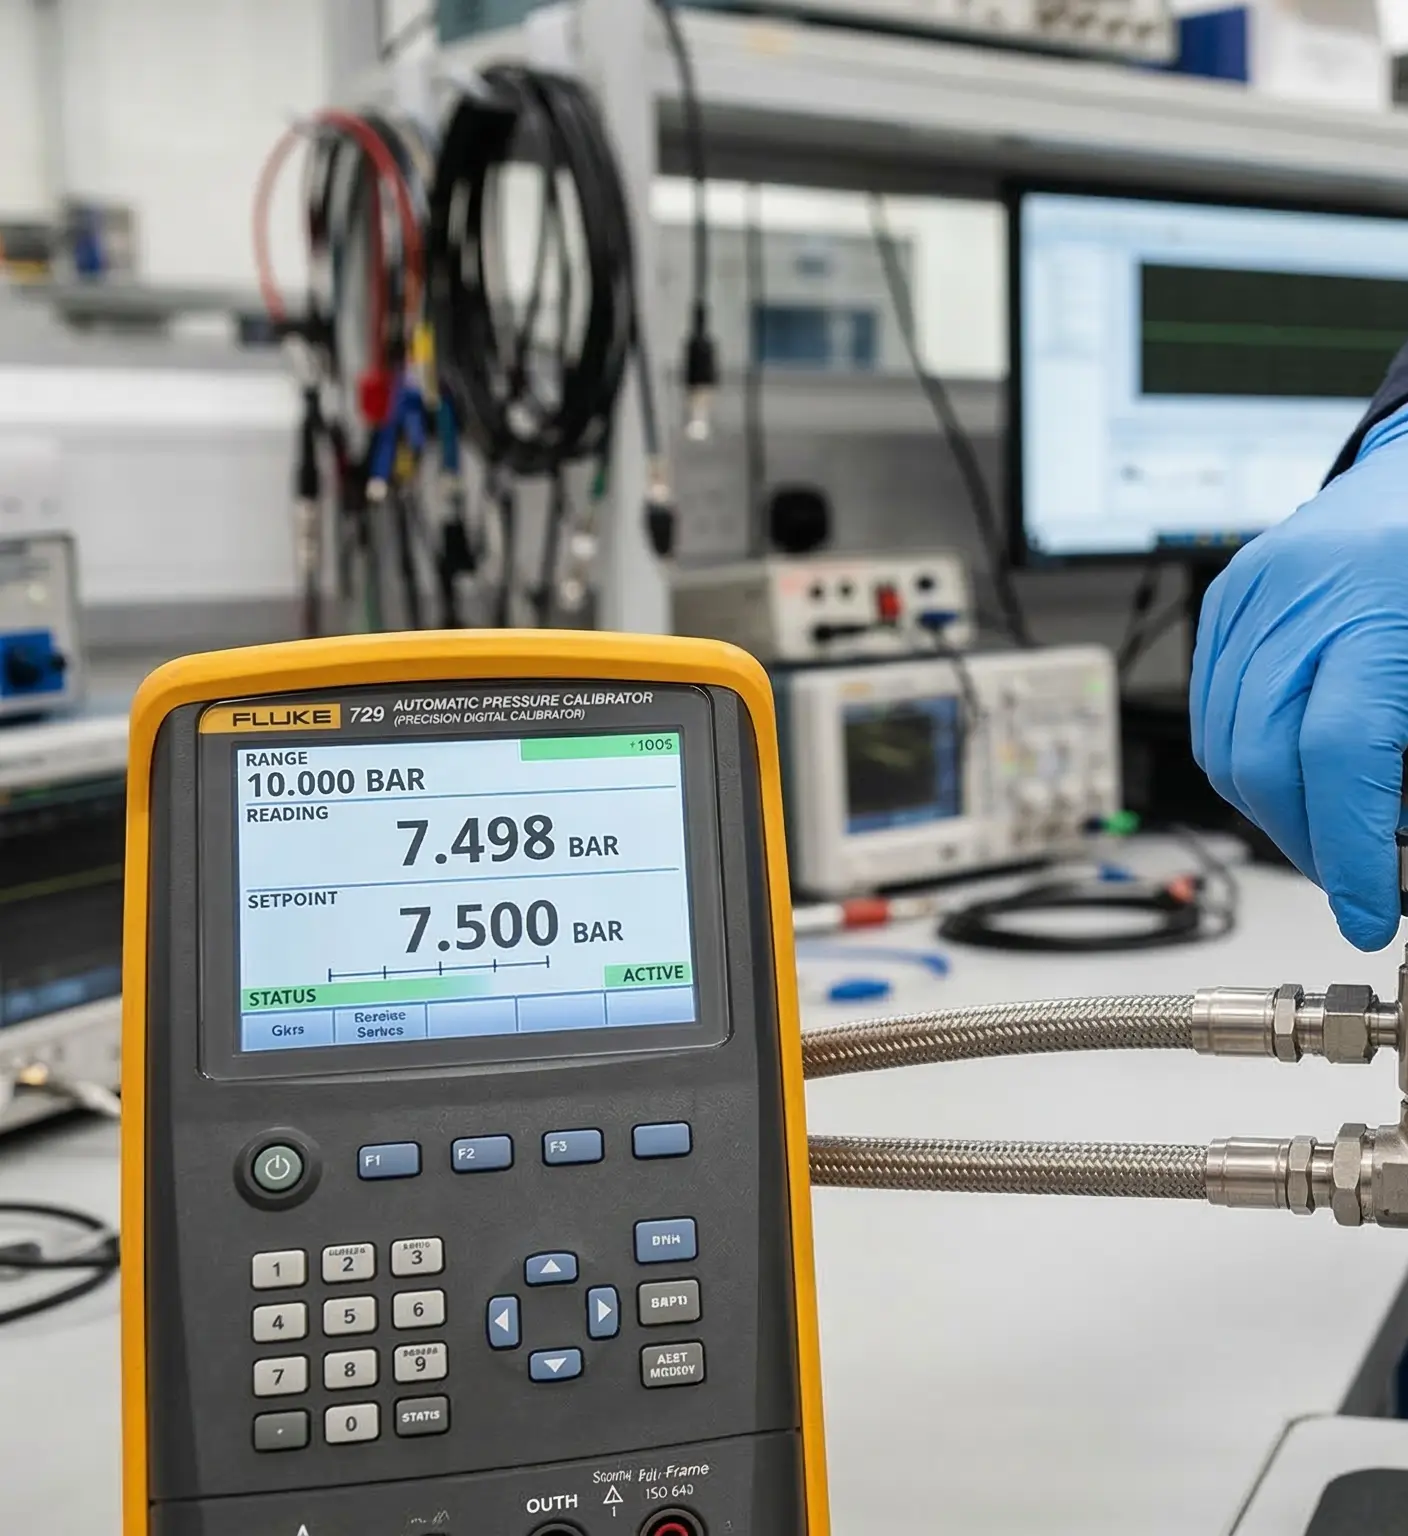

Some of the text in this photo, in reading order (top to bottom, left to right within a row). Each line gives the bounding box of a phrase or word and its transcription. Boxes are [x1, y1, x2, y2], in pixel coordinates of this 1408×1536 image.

[393, 691, 654, 712] AUTOMATIC PRESSURE CALIBRATOR
[232, 706, 385, 727] FLUKE 729
[394, 713, 461, 728] (PRECISION
[463, 711, 508, 724] DIGITAL
[245, 751, 308, 767] RANGE
[247, 767, 425, 798] 10.000 BAR
[246, 805, 329, 823] READING
[396, 813, 620, 867] 7.498 BAR
[247, 890, 338, 910] SETPOINT
[399, 898, 624, 954] 7.500 BAR
[623, 963, 684, 984] ACTIVE
[249, 988, 317, 1007] STATUS
[365, 1154, 381, 1168] F1
[457, 1147, 476, 1161] F2
[342, 1256, 354, 1273] 2
[411, 1250, 423, 1265] 3
[272, 1262, 281, 1278] 1
[344, 1308, 356, 1324] 5
[412, 1301, 424, 1317] 6
[271, 1314, 285, 1330] 4
[343, 1361, 356, 1378] 8
[414, 1356, 426, 1372] 9
[272, 1368, 285, 1386] 7
[345, 1416, 357, 1432] 0
[525, 1492, 579, 1515] OUTH
